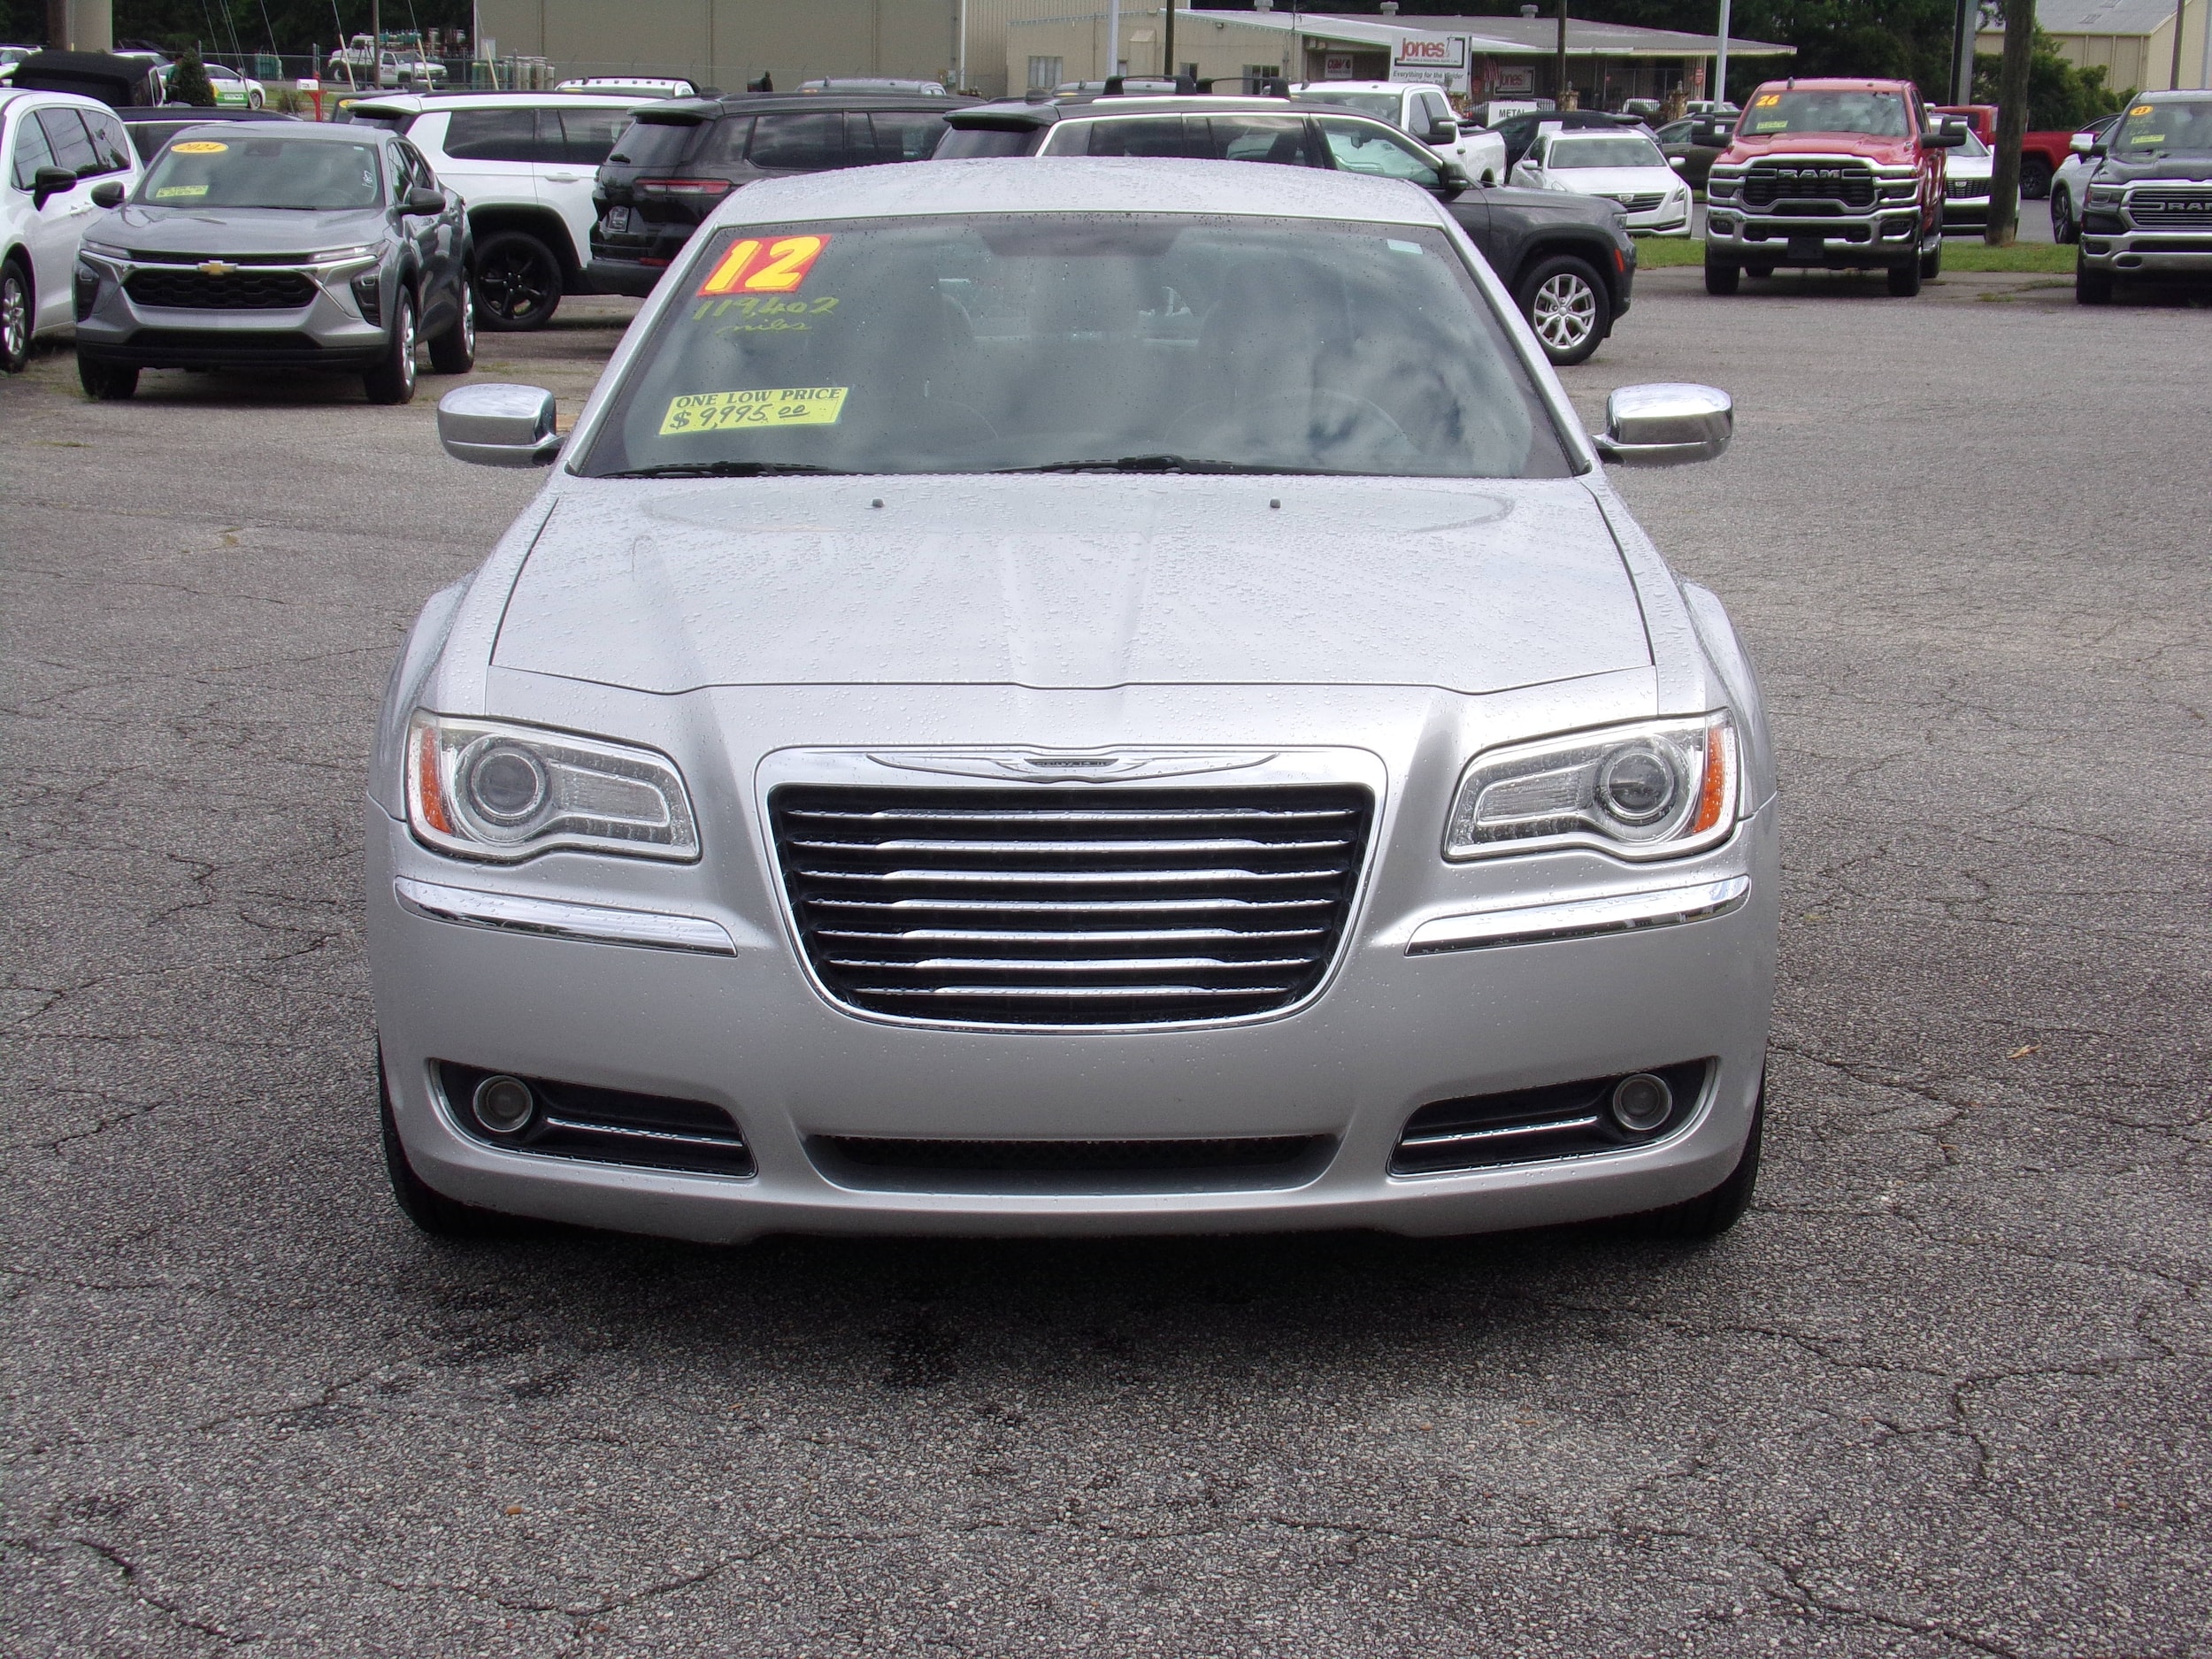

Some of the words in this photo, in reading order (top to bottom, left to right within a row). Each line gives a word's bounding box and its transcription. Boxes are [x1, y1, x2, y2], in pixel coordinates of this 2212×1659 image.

[1399, 37, 1445, 61] jones
[1755, 95, 1779, 107] 26
[1778, 169, 1840, 178] RAM
[703, 235, 822, 292] 12
[676, 394, 718, 408] ONE
[727, 390, 772, 403] LOW
[780, 388, 841, 401] PRICE
